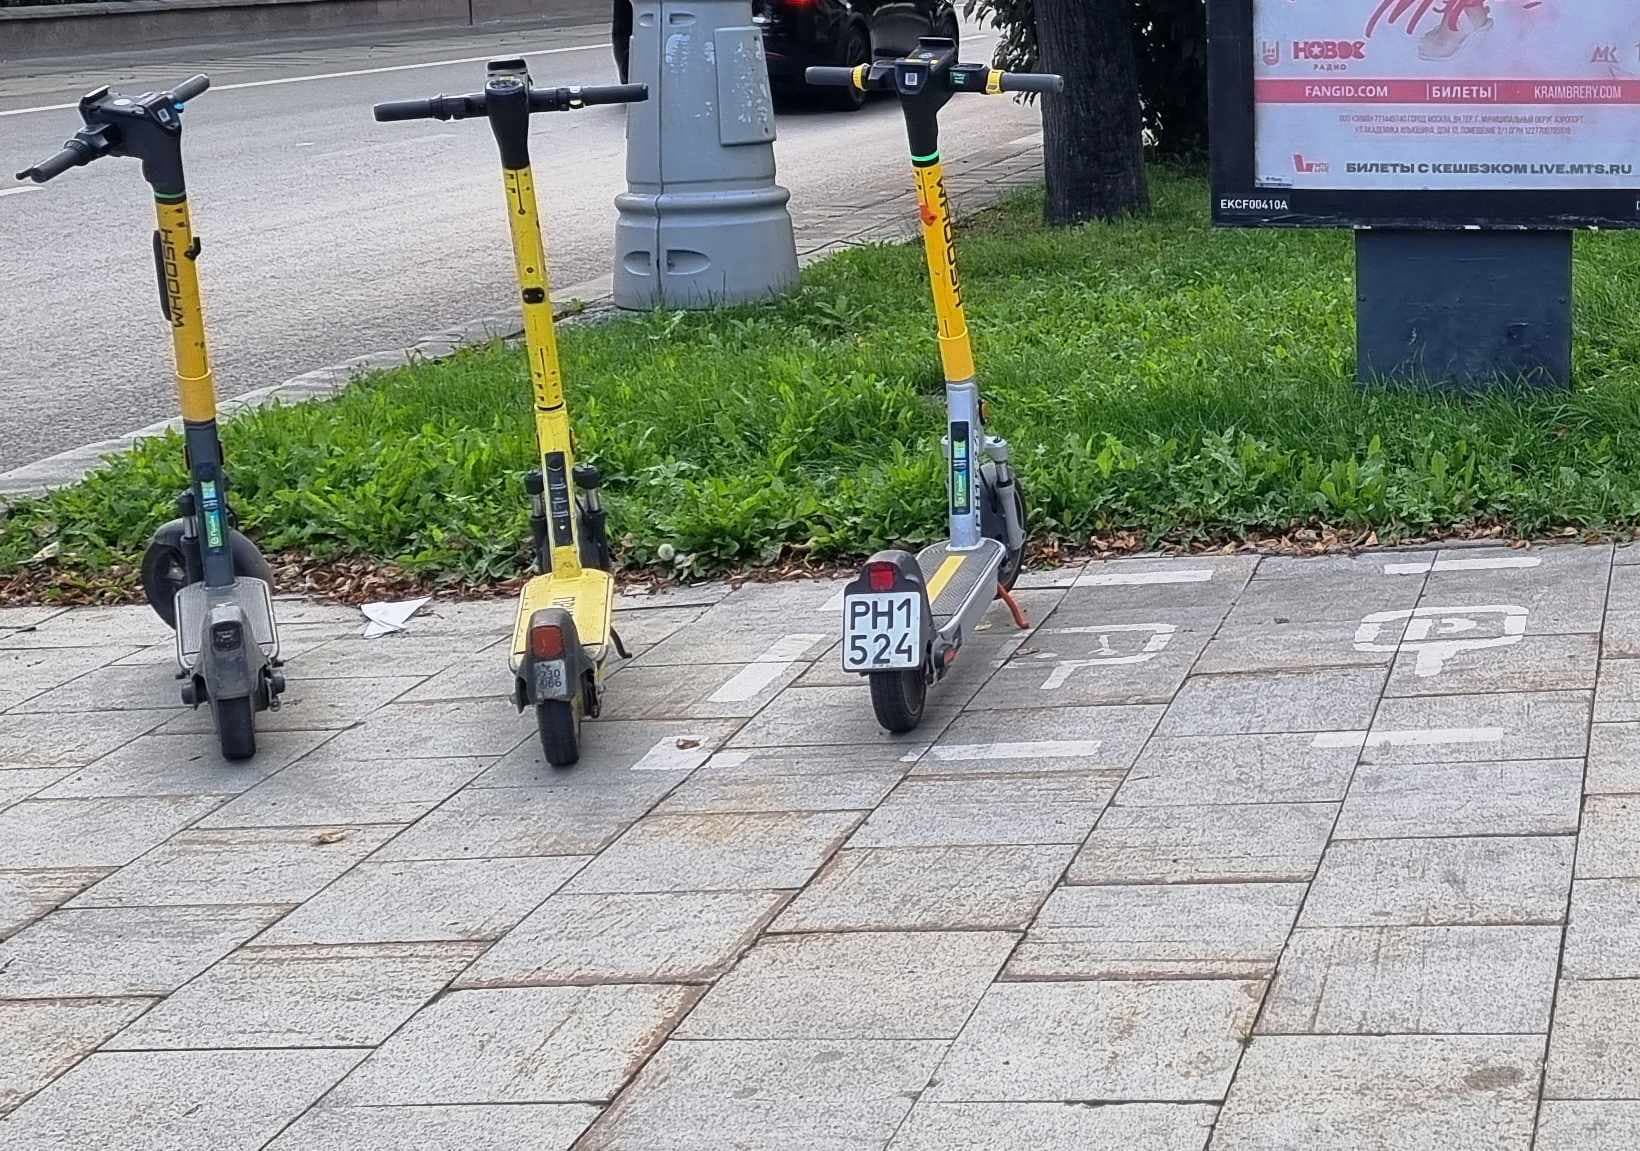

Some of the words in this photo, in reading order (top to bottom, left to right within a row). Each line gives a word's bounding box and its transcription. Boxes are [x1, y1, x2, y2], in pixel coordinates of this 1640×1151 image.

[1313, 63, 1348, 71] РАДИО
[1304, 85, 1389, 98] FANGID.COM
[1431, 85, 1493, 100] БИЛЕТЫ
[1534, 85, 1623, 99] KRAIMBRERY.COM
[1345, 162, 1416, 174] БИЛЕТЫ
[1418, 163, 1430, 174] С
[1432, 162, 1528, 175] КЕШБЭКОМ
[1530, 163, 1633, 175] LIVE.MTS.RU
[1220, 198, 1289, 211] EKCF00410A
[936, 176, 963, 309] WHOOSH
[161, 228, 185, 328] WHOOSH
[849, 598, 912, 630] PH1
[848, 632, 913, 666] 524
